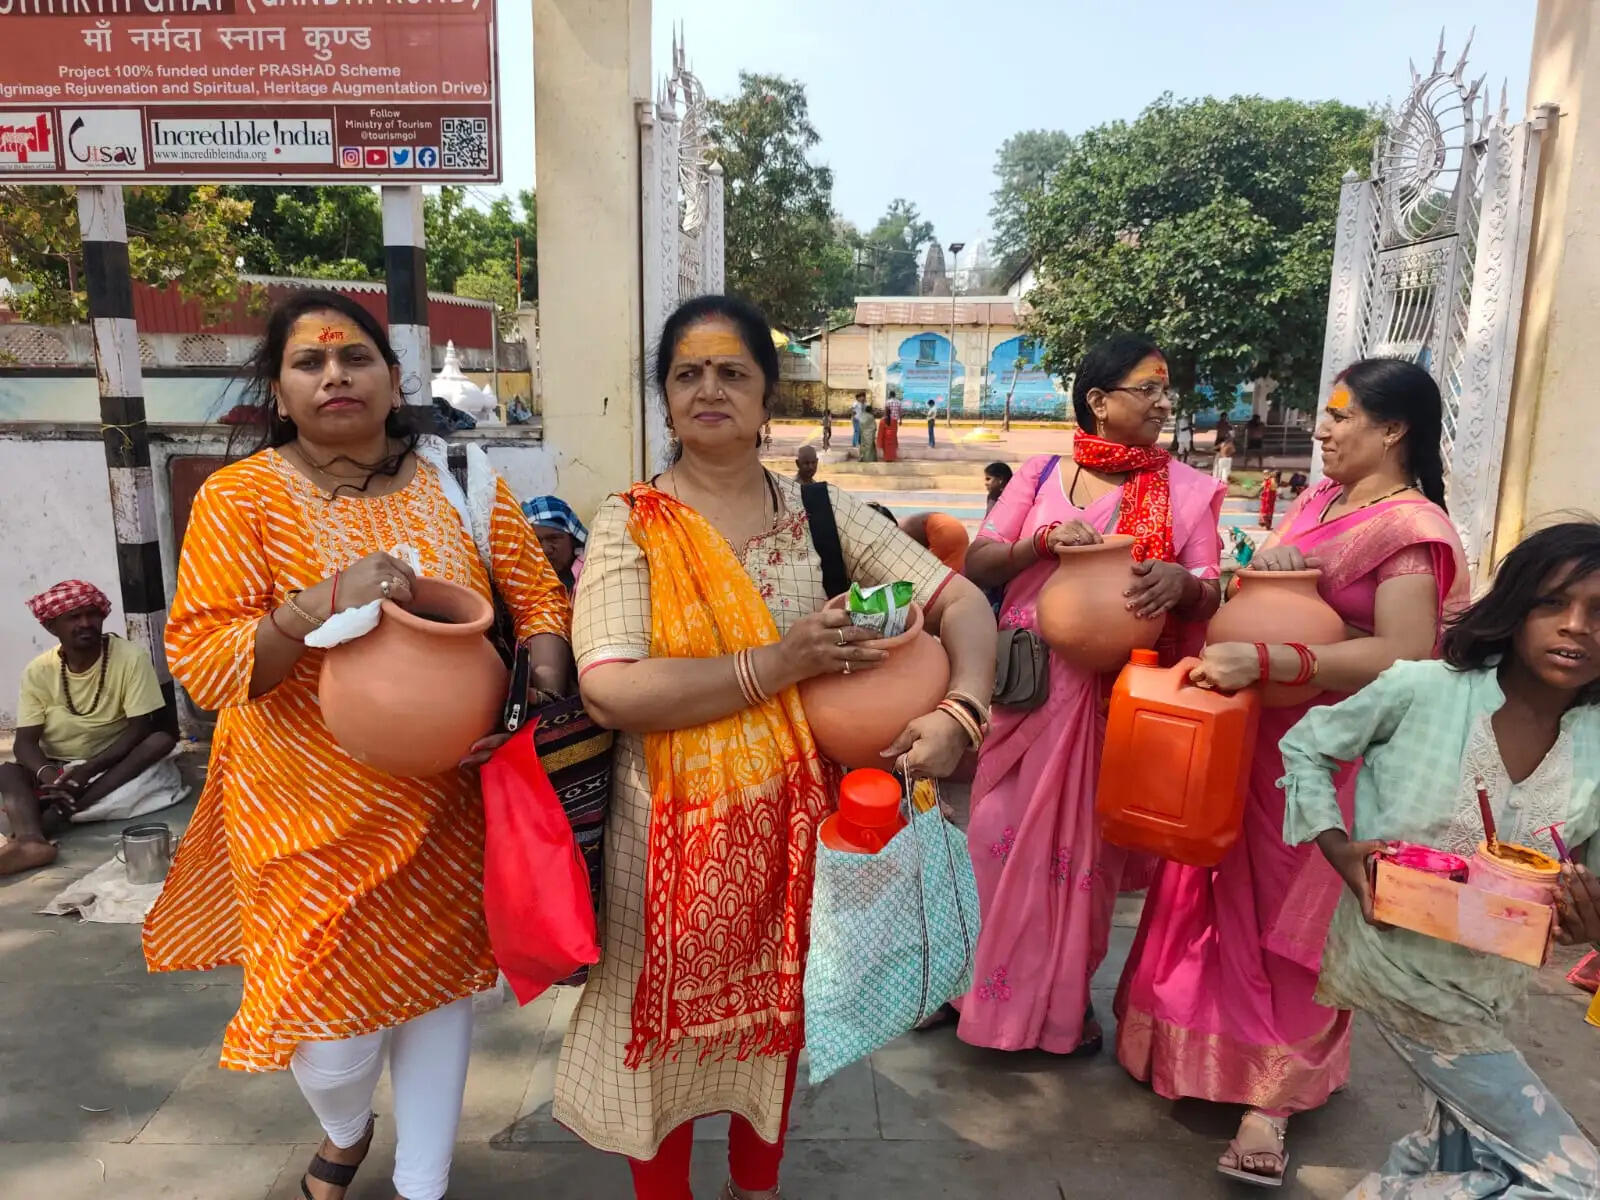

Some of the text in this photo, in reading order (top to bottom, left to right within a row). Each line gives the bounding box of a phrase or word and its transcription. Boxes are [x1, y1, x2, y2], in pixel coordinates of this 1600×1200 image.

[81, 19, 371, 61] माँ नर्मदा स्नान कुण्ड
[59, 64, 401, 80] Project 100% funded under PRASHAD Scheme
[65, 82, 158, 97] Rejuvenation
[162, 82, 189, 94] and
[193, 81, 260, 97] Spiritual,
[264, 81, 328, 97] Heritage
[332, 81, 438, 96] Augmentation
[442, 80, 488, 96] Drive)
[370, 109, 400, 118] Follow
[345, 119, 433, 130] Ministry of Tourism
[153, 120, 271, 146] Incredible
[154, 148, 267, 161] www.incredibleindia.org
